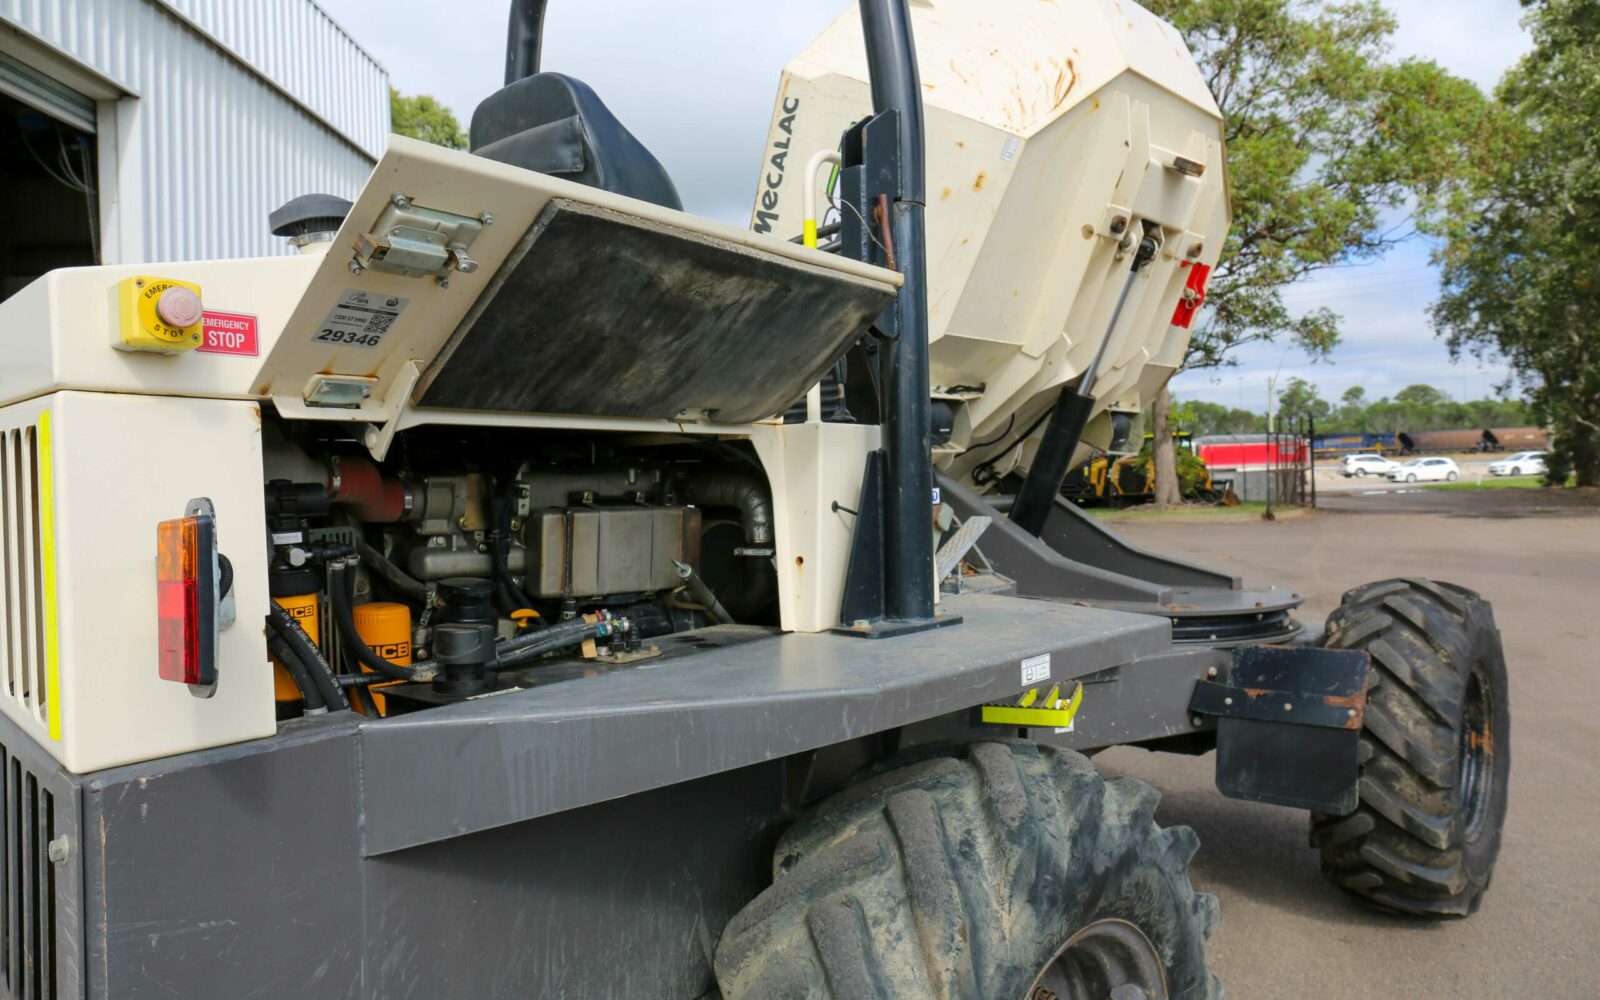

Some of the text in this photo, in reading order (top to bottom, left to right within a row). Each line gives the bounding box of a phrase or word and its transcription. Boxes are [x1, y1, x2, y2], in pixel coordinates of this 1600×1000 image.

[154, 323, 185, 338] STOP
[203, 317, 249, 331] EMERGENCY
[208, 330, 245, 348] STOP
[317, 328, 381, 347] 29346
